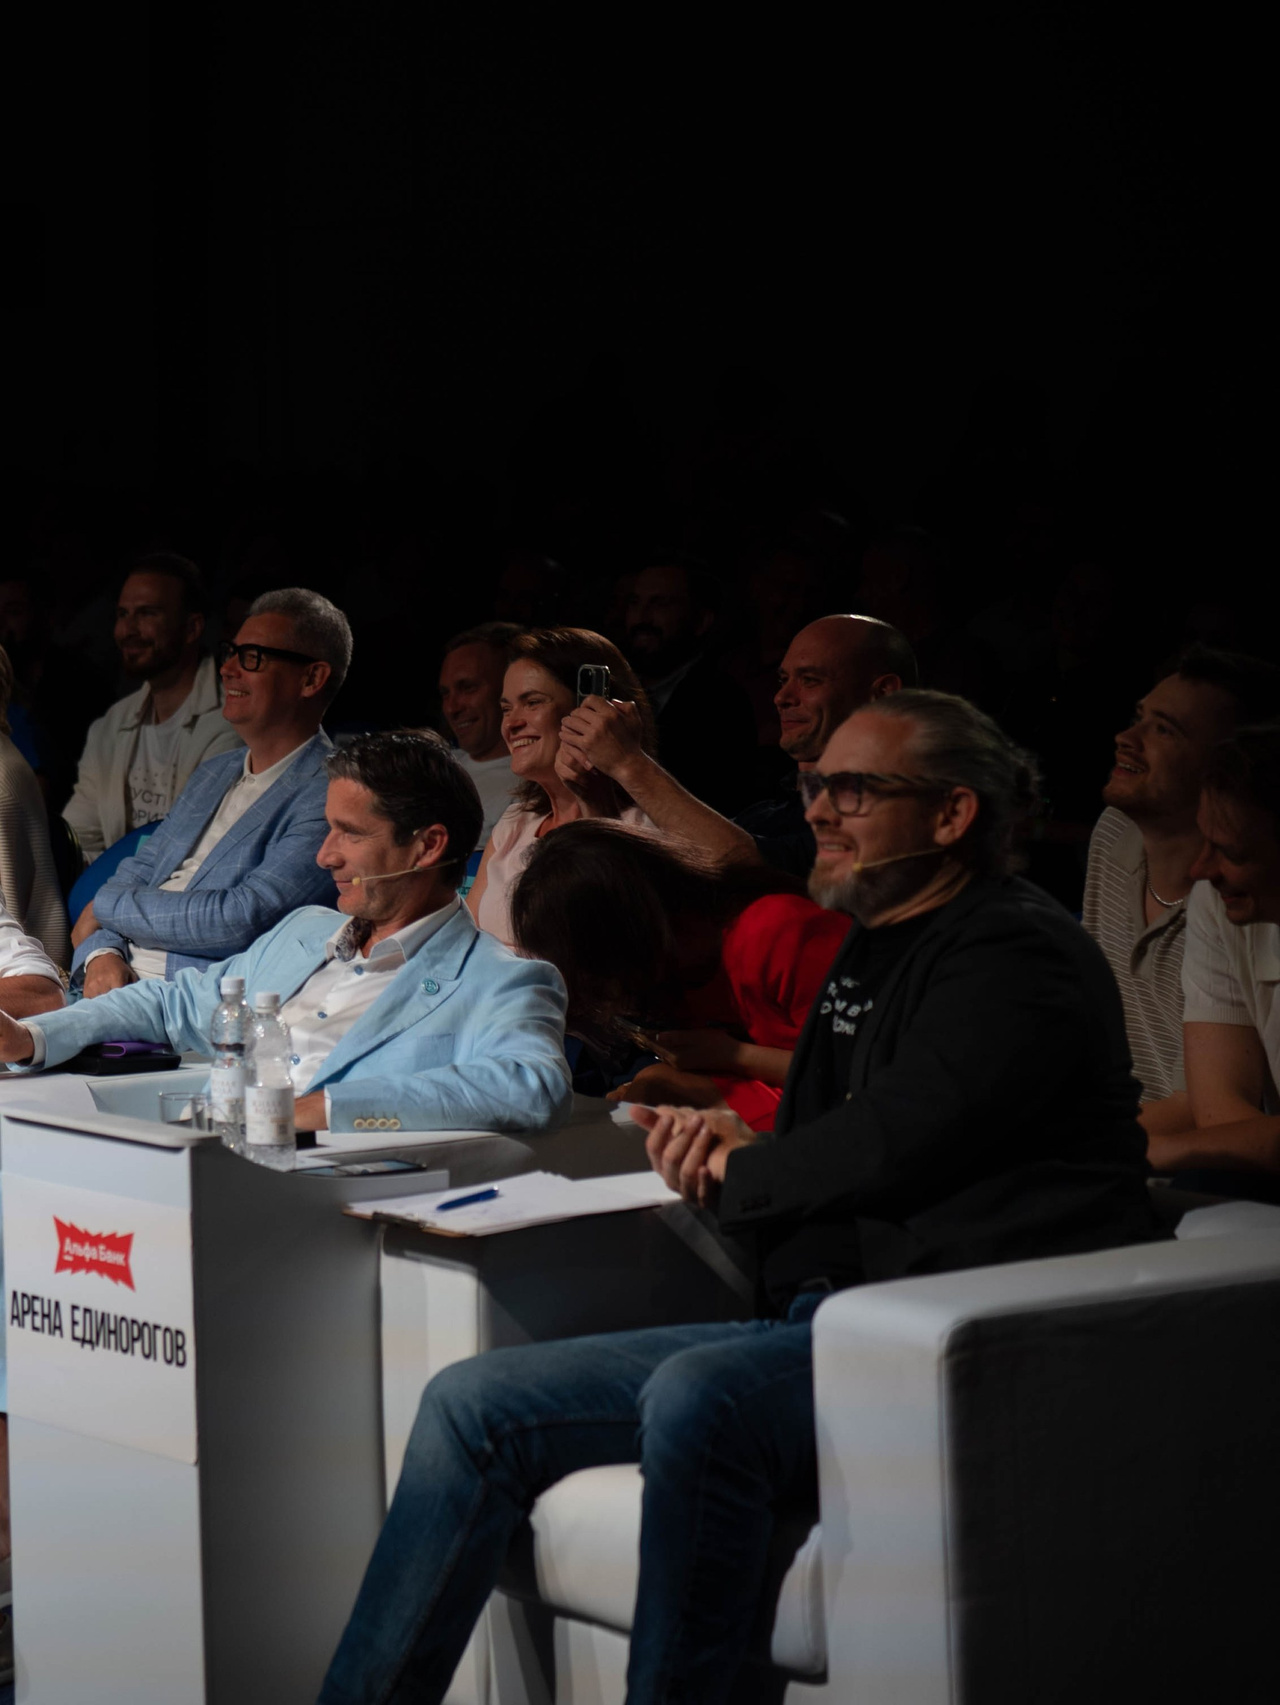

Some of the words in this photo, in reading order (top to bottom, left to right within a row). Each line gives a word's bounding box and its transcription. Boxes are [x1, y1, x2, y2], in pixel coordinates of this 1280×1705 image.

[63, 1236, 97, 1262] Альфа
[98, 1243, 127, 1267] Банк
[11, 1290, 64, 1339] АРЕНА
[70, 1304, 187, 1368] ЕДИНОРОГОВ
